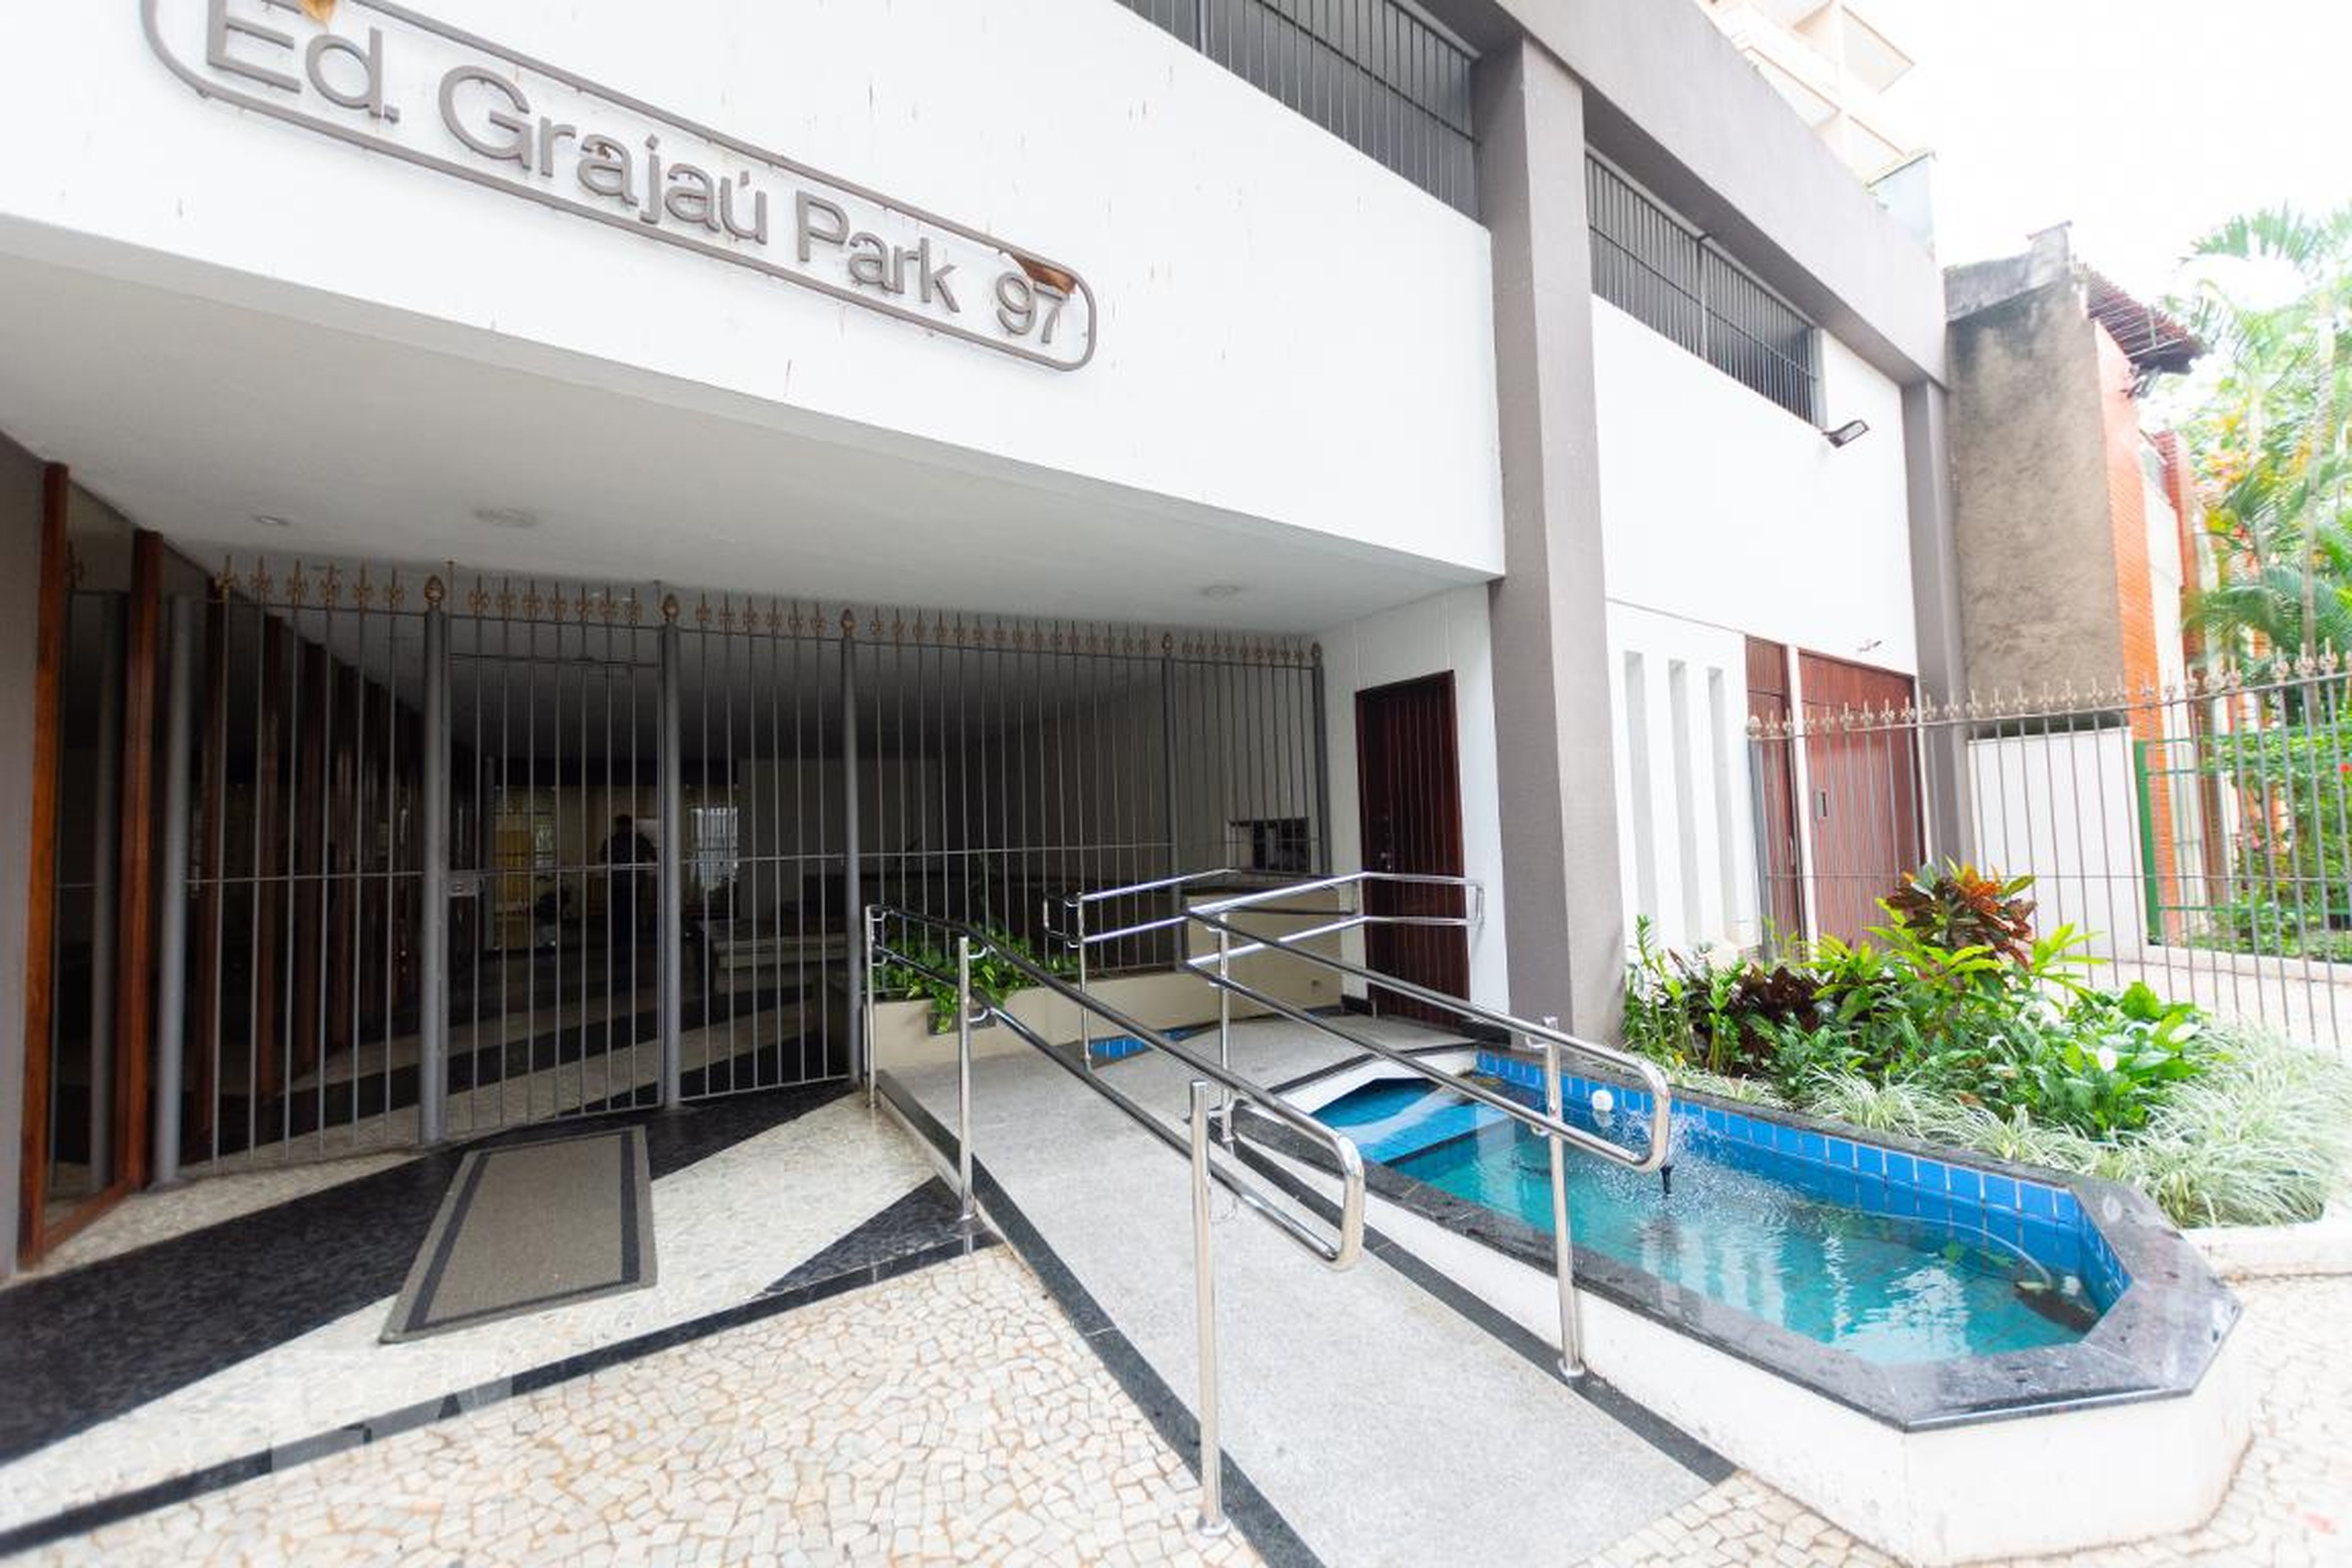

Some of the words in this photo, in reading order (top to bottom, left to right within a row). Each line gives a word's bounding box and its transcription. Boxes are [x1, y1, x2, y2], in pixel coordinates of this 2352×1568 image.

[207, 0, 399, 124] Ed.
[439, 65, 767, 244] Grajaú
[796, 190, 960, 313] Park
[996, 271, 1070, 344] 97
